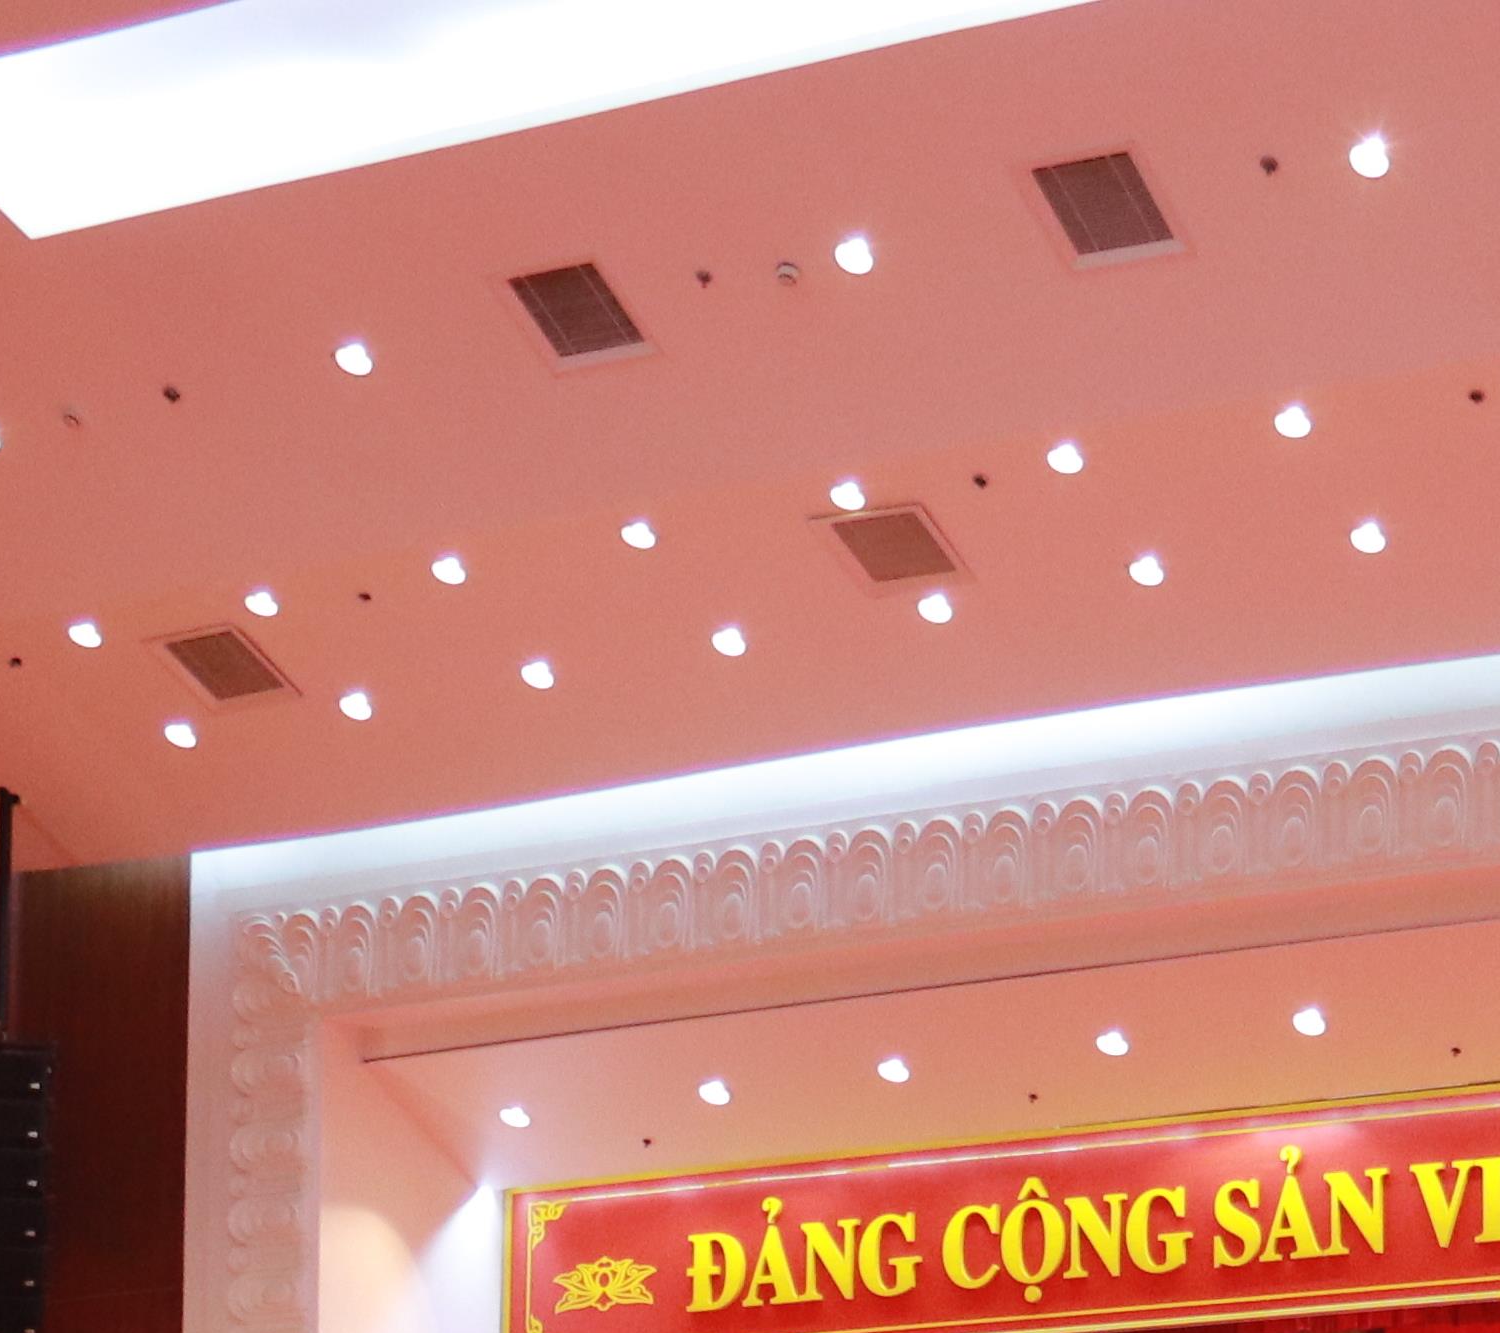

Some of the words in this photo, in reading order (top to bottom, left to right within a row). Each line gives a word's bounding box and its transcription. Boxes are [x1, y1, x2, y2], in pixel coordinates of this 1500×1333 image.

[687, 1197, 922, 1311] ĐẢNG
[943, 1177, 1193, 1301] CỘNG
[1214, 1145, 1389, 1266] SẢN
